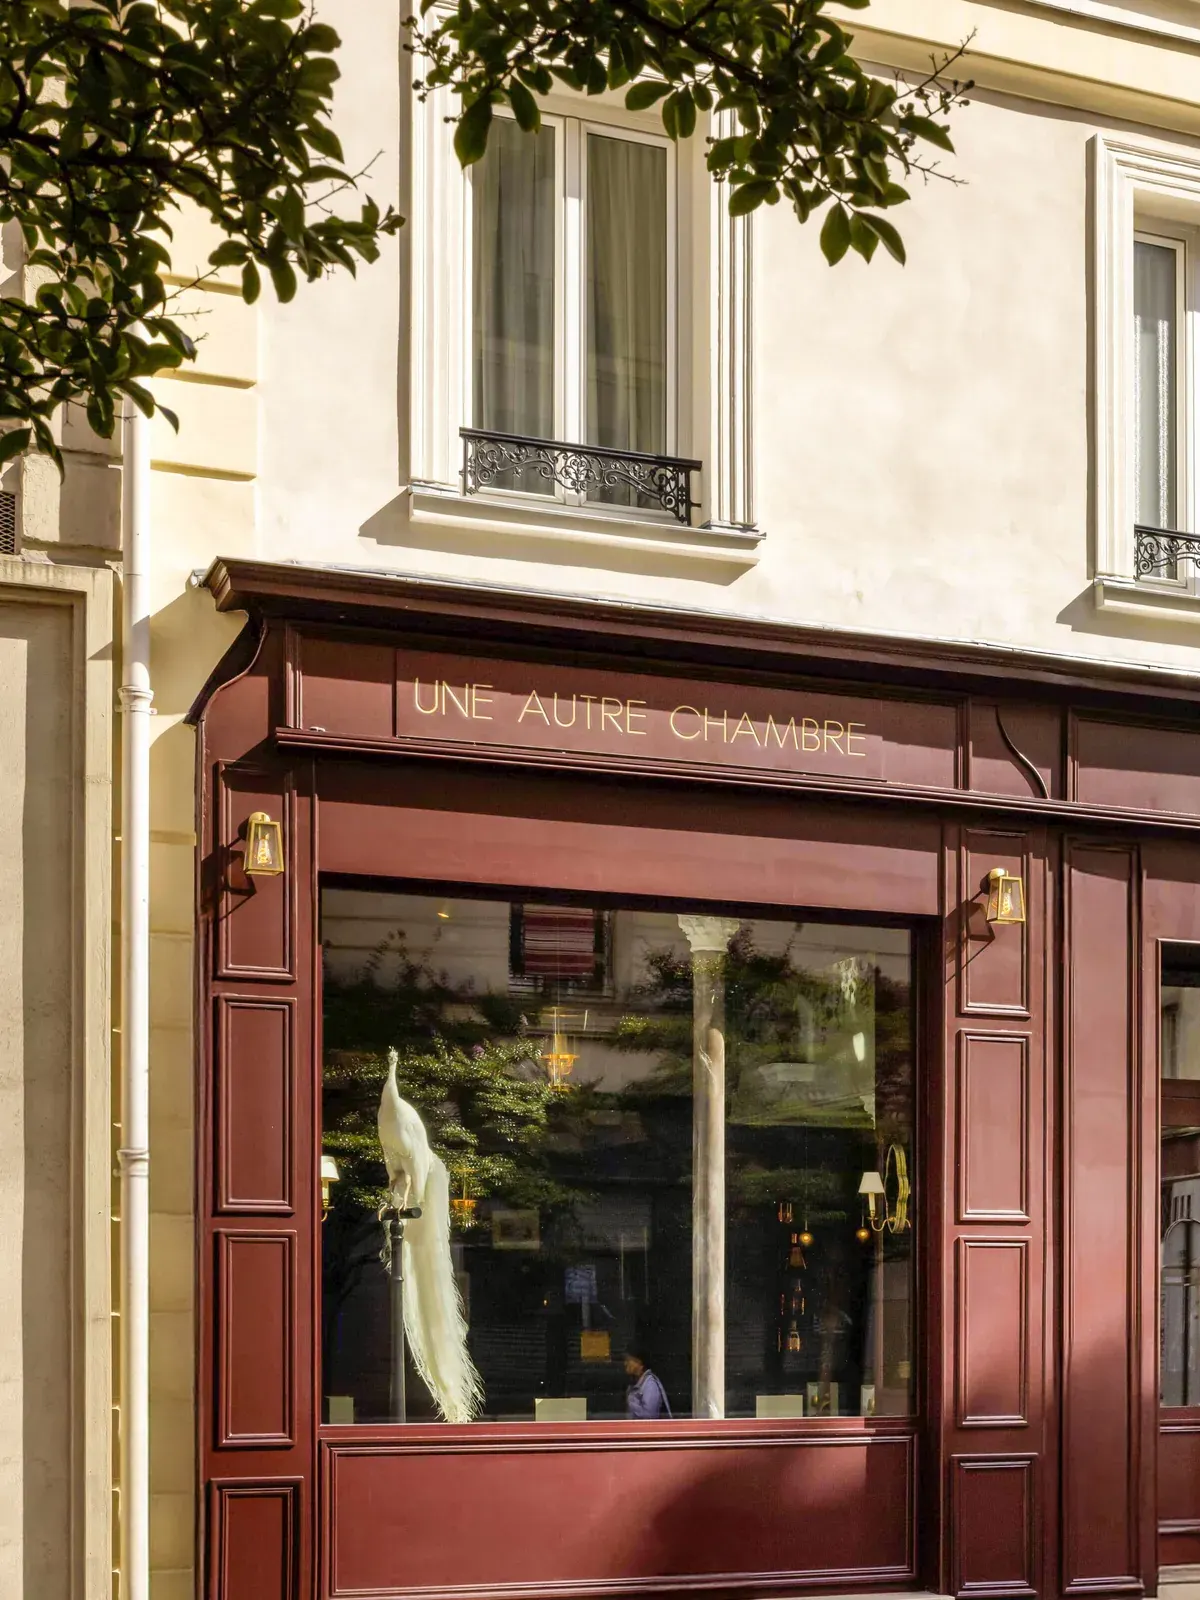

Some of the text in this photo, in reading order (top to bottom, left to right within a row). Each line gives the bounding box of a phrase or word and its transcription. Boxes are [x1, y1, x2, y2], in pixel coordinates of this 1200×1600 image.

[413, 677, 867, 757] UNE AUTRE CHAMBRE
